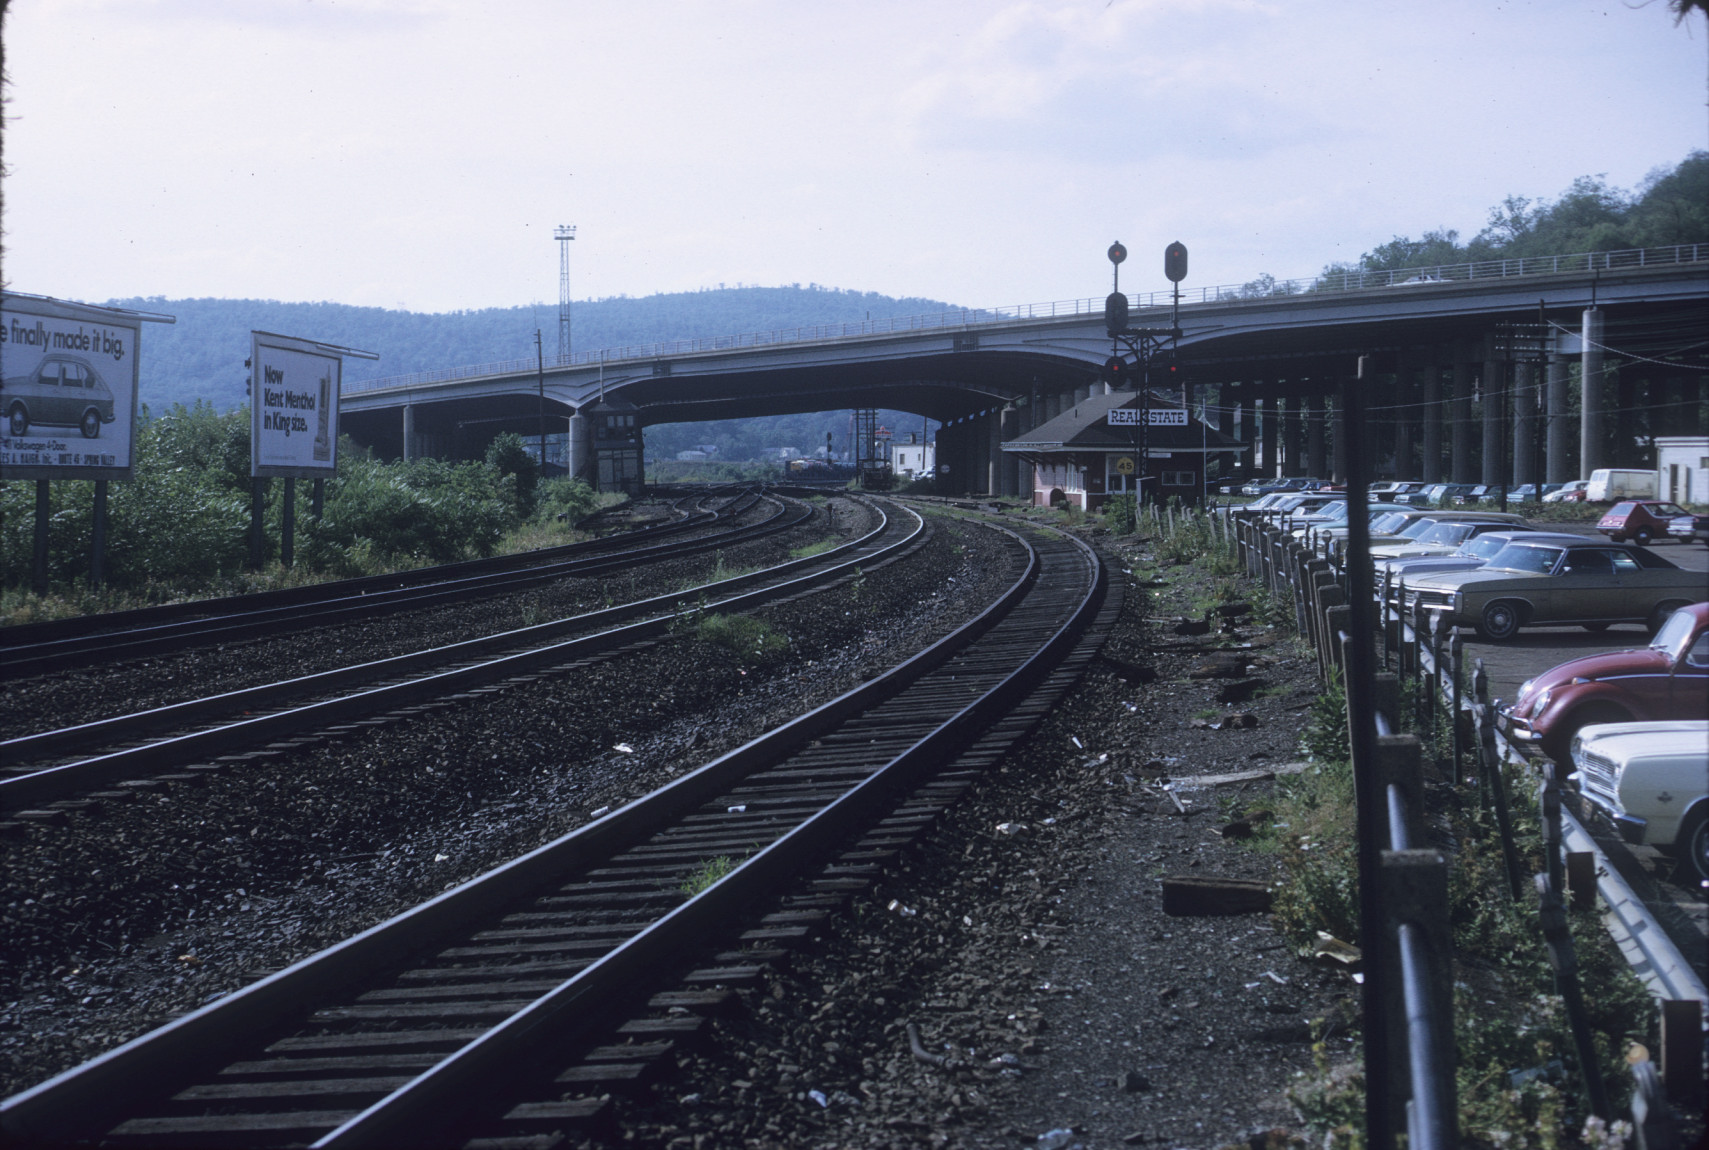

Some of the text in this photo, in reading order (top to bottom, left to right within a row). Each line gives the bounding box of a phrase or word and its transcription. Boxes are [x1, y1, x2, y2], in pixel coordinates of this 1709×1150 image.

[11, 318, 51, 353] finally
[53, 326, 90, 351] made
[92, 328, 101, 352] it
[102, 329, 125, 360] big.
[264, 365, 283, 384] Now
[264, 388, 316, 411] Kent Menthol
[264, 411, 308, 437] in King size.
[1143, 411, 1184, 423] STATE
[13, 438, 46, 453] Volkswagen
[1118, 462, 1132, 470] 45
